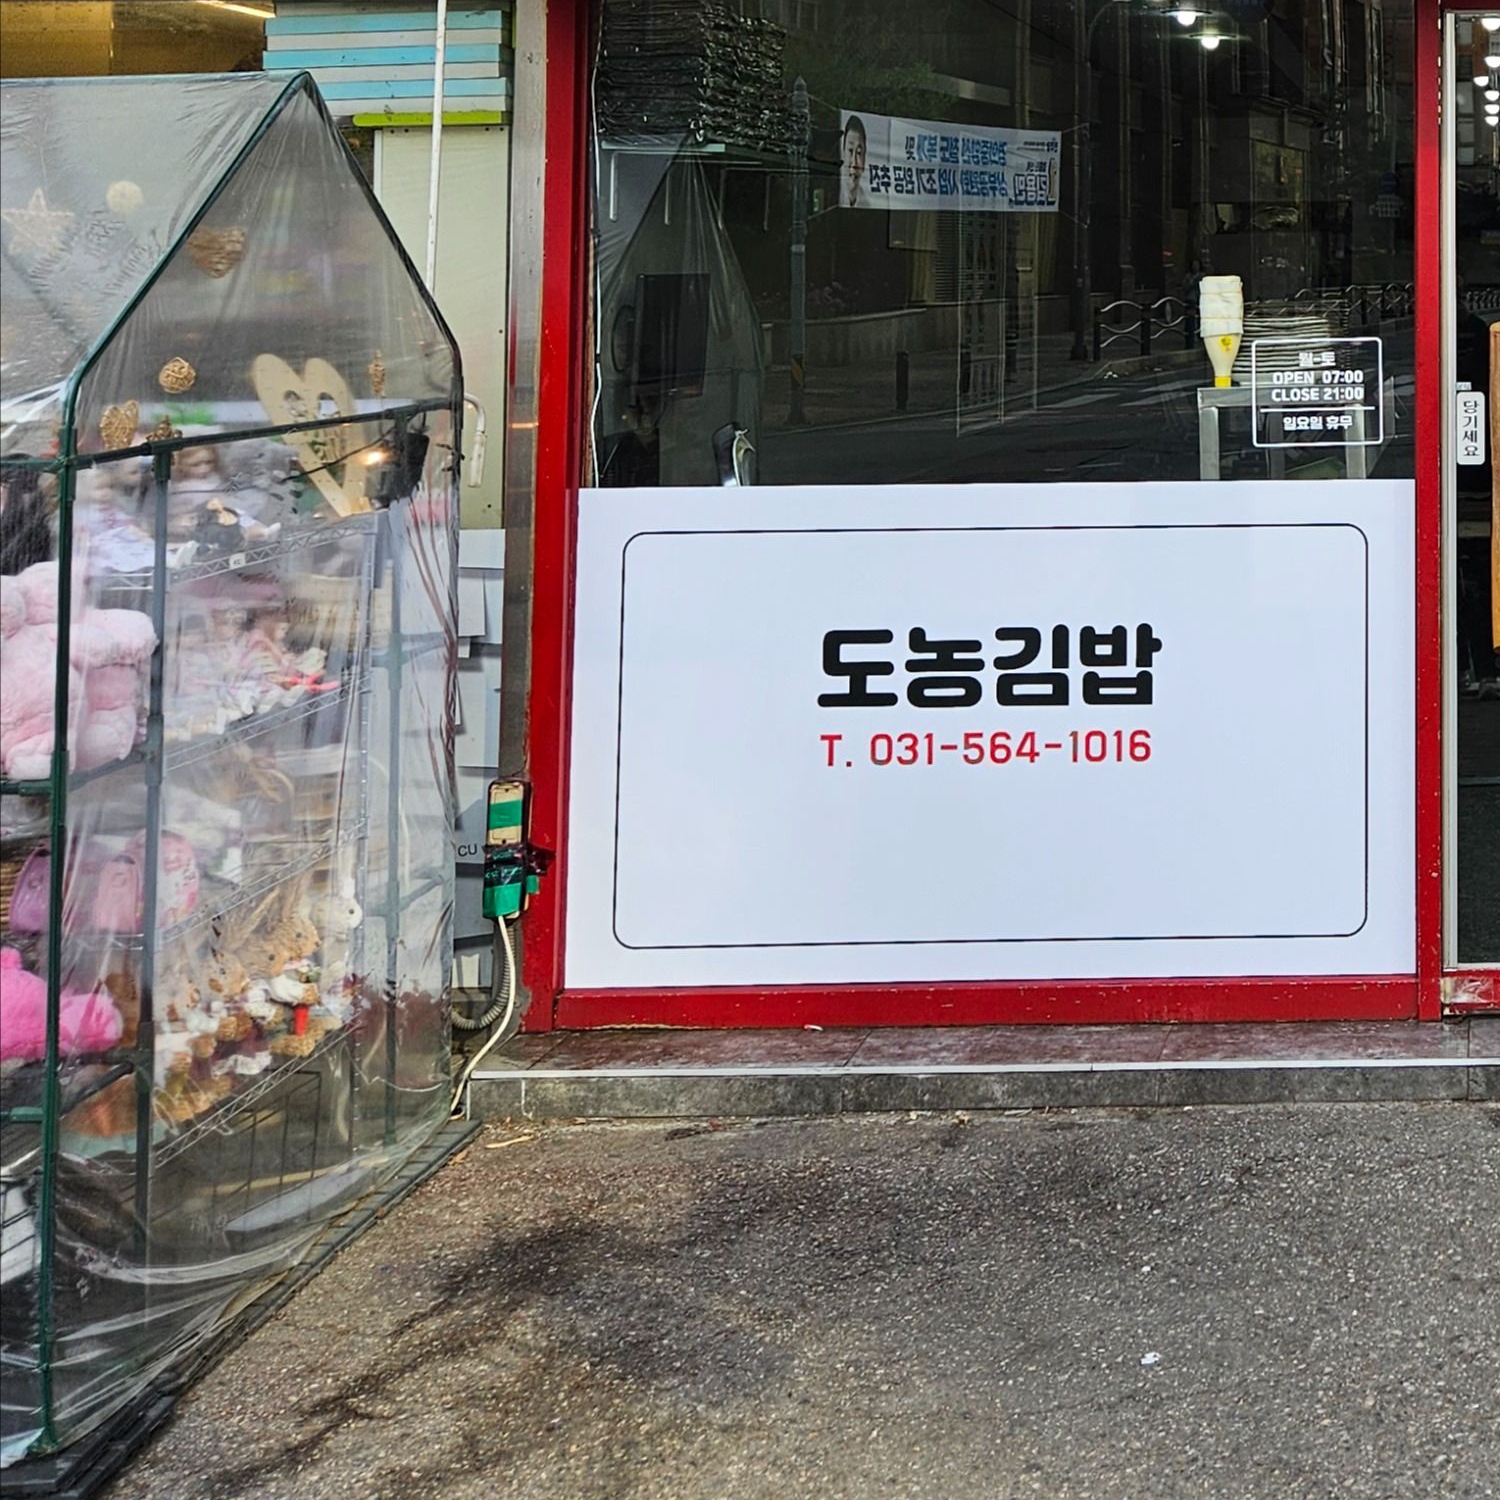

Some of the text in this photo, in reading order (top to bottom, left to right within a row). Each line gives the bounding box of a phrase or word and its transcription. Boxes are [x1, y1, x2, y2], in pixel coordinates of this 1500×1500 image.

[1272, 370, 1364, 384] OPEN 07:00
[1271, 386, 1364, 401] CLOSE 21:00
[1326, 415, 1353, 430] 휴무
[1463, 400, 1480, 457] 당기세요
[817, 622, 1163, 709] 도농김밥
[820, 729, 1152, 768] T. 031-564-1016
[457, 843, 478, 857] CU
